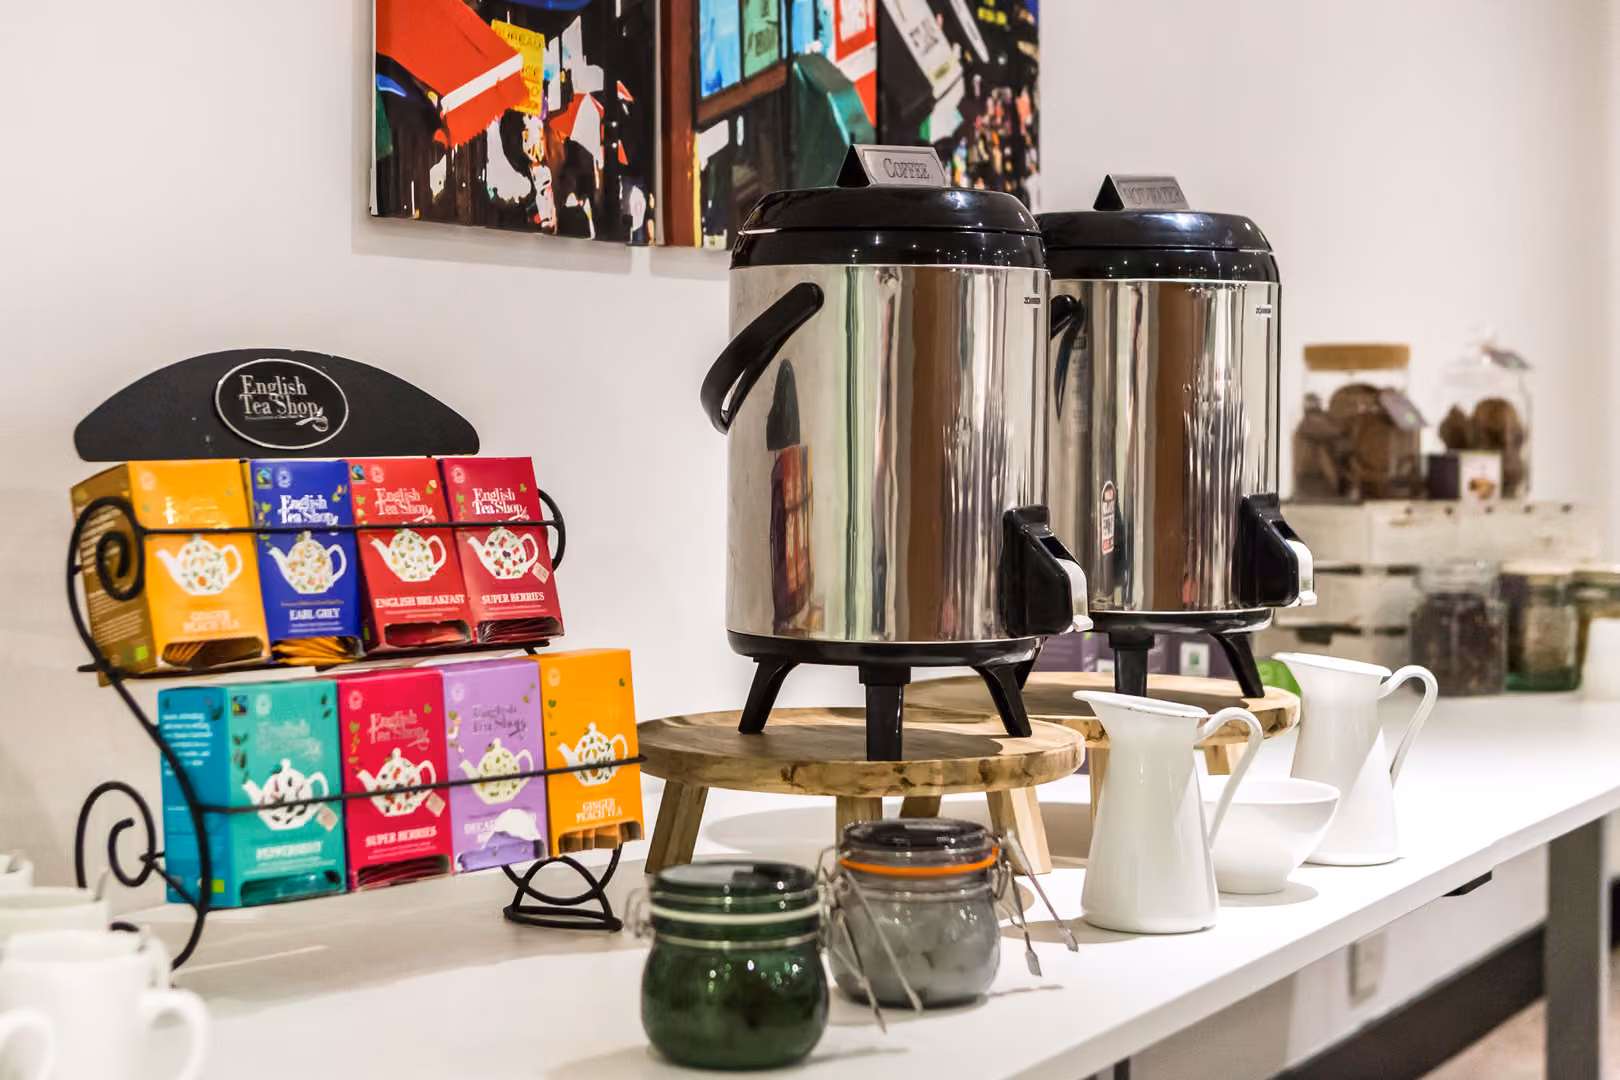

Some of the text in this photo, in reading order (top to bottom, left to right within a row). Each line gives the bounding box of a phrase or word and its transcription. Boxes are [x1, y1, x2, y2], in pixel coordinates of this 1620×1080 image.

[239, 374, 308, 396] English
[239, 393, 324, 422] Tea Shop
[279, 494, 328, 511] English
[375, 487, 421, 503] English
[472, 487, 516, 503] English
[375, 499, 432, 519] Tea Shop
[472, 499, 524, 519] Tea Shop
[375, 594, 465, 609] ENGLISH BREAKFAST
[482, 591, 545, 605] SUPER BERRIES
[289, 607, 341, 622] EARL GREY
[365, 826, 438, 848] SUPER BERRIES
